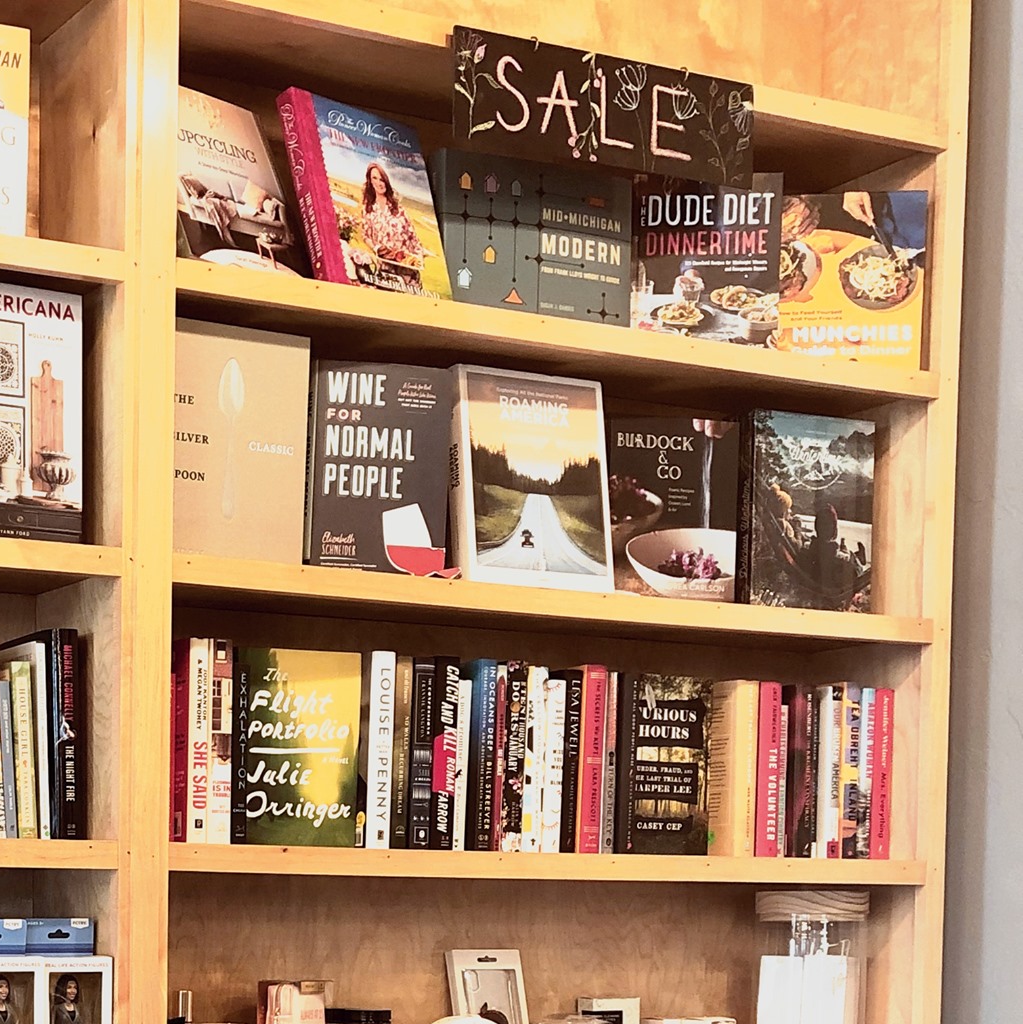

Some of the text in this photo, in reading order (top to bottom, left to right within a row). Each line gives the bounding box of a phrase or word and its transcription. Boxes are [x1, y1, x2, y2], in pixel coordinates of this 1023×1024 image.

[494, 55, 692, 161] SALE
[648, 192, 775, 227] DUDE DIET
[645, 229, 769, 257] DINNERTIME
[792, 324, 913, 342] MUNCHIES
[327, 370, 387, 407] WINE
[326, 408, 362, 422] FOR
[248, 441, 294, 456] CLASSIC
[325, 424, 415, 461] NORMAL
[323, 463, 404, 500] PEOPLE
[250, 690, 333, 719] Flight
[376, 668, 391, 821] LOUISE PENNY
[65, 745, 76, 802] THE NIGHT FIRE
[246, 790, 351, 828] Orringer
[636, 821, 664, 830] CASEY
